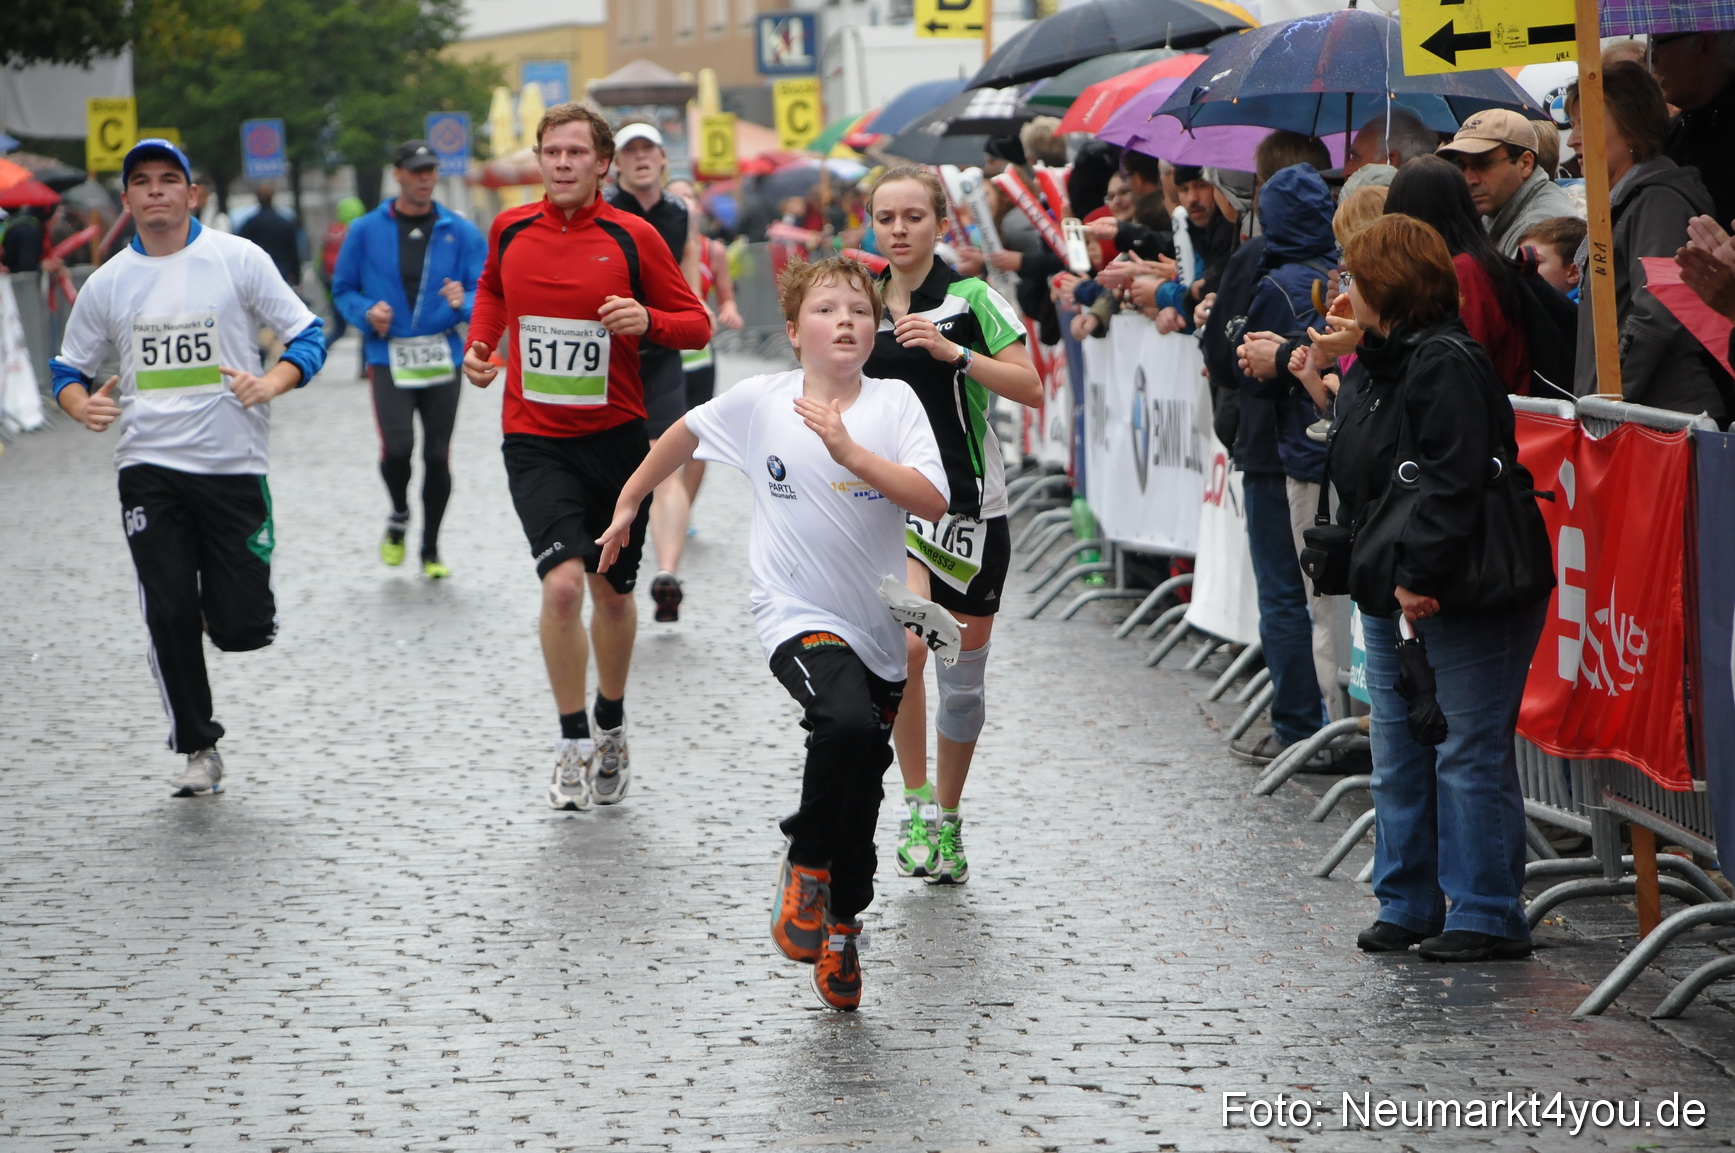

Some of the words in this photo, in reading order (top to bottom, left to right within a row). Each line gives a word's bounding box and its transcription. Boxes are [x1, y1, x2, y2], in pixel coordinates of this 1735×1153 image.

[786, 100, 812, 135] C
[99, 117, 123, 153] C
[133, 323, 161, 333] PARTL
[163, 320, 202, 331] Neumarkt
[520, 323, 549, 335] PARTL
[550, 326, 594, 338] Neumarkt
[142, 332, 212, 366] 5165
[528, 337, 601, 371] 5179
[768, 481, 796, 494] PARTL
[770, 490, 798, 501] Neumarkt
[917, 538, 956, 571] Vanessa
